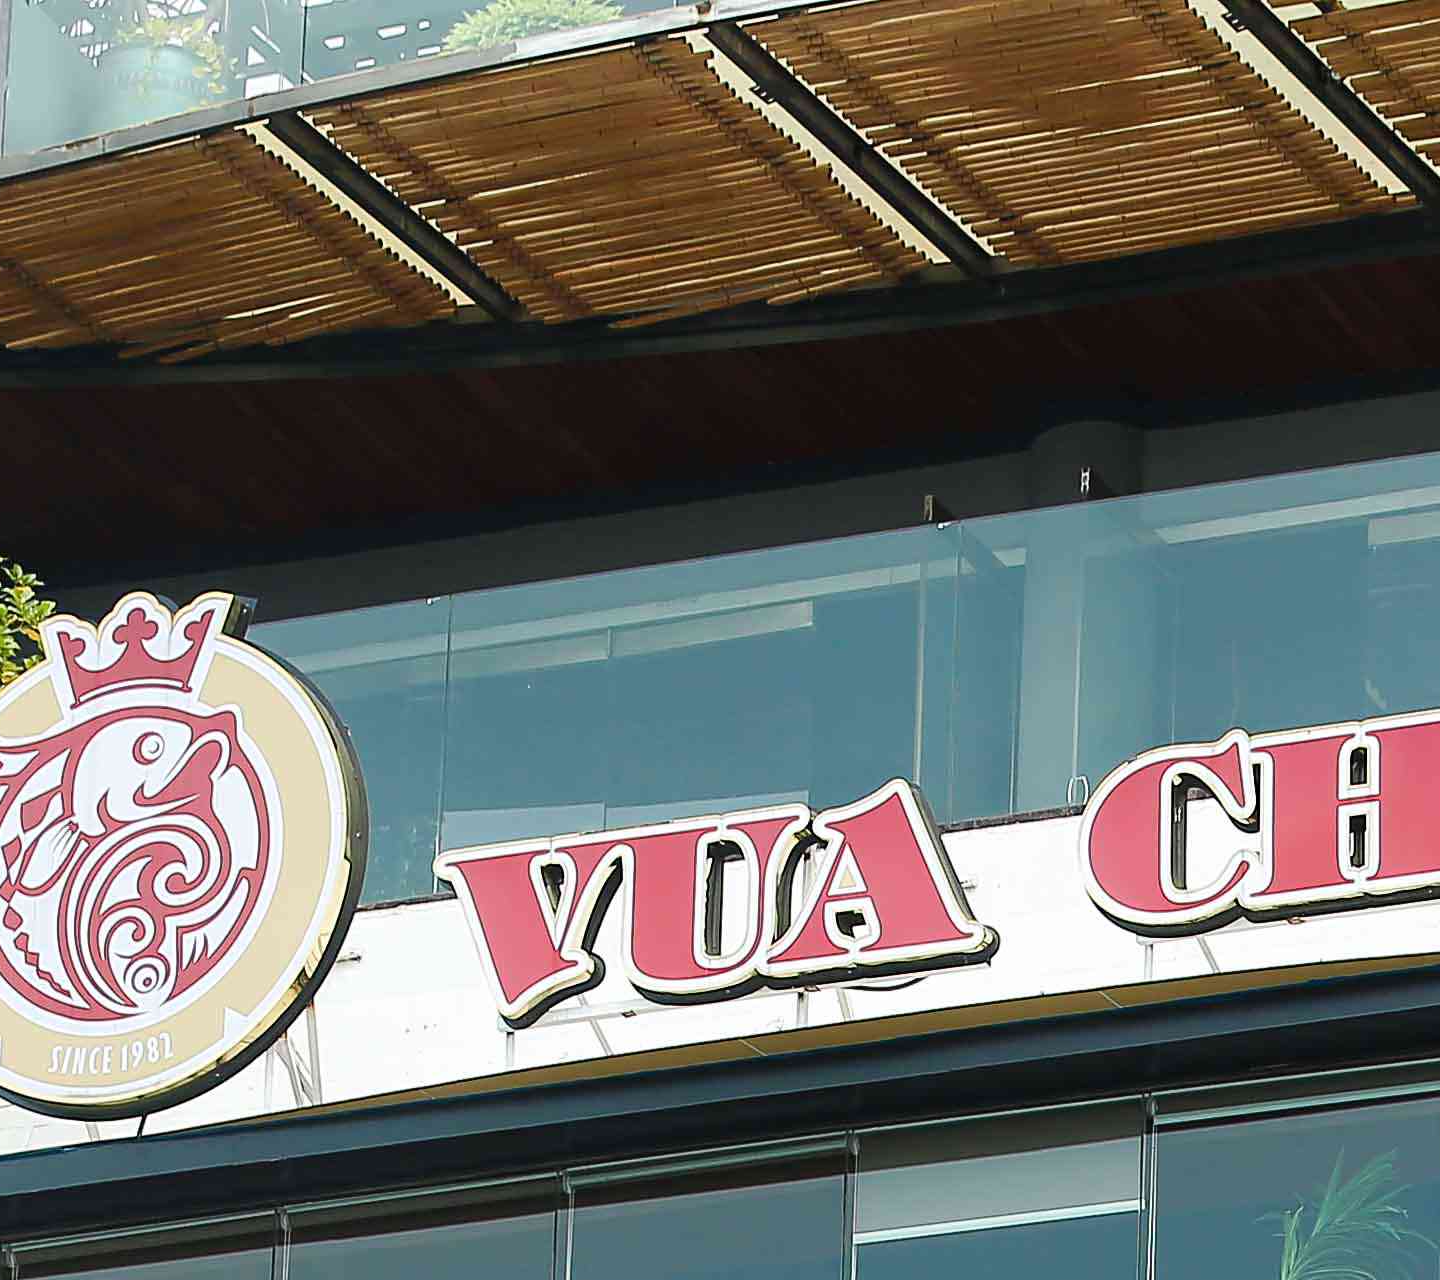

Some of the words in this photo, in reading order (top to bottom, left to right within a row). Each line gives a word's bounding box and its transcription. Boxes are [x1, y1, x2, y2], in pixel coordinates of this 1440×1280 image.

[434, 778, 994, 1024] VUA
[48, 1045, 112, 1075] SINCE
[119, 1032, 174, 1073] 1982
